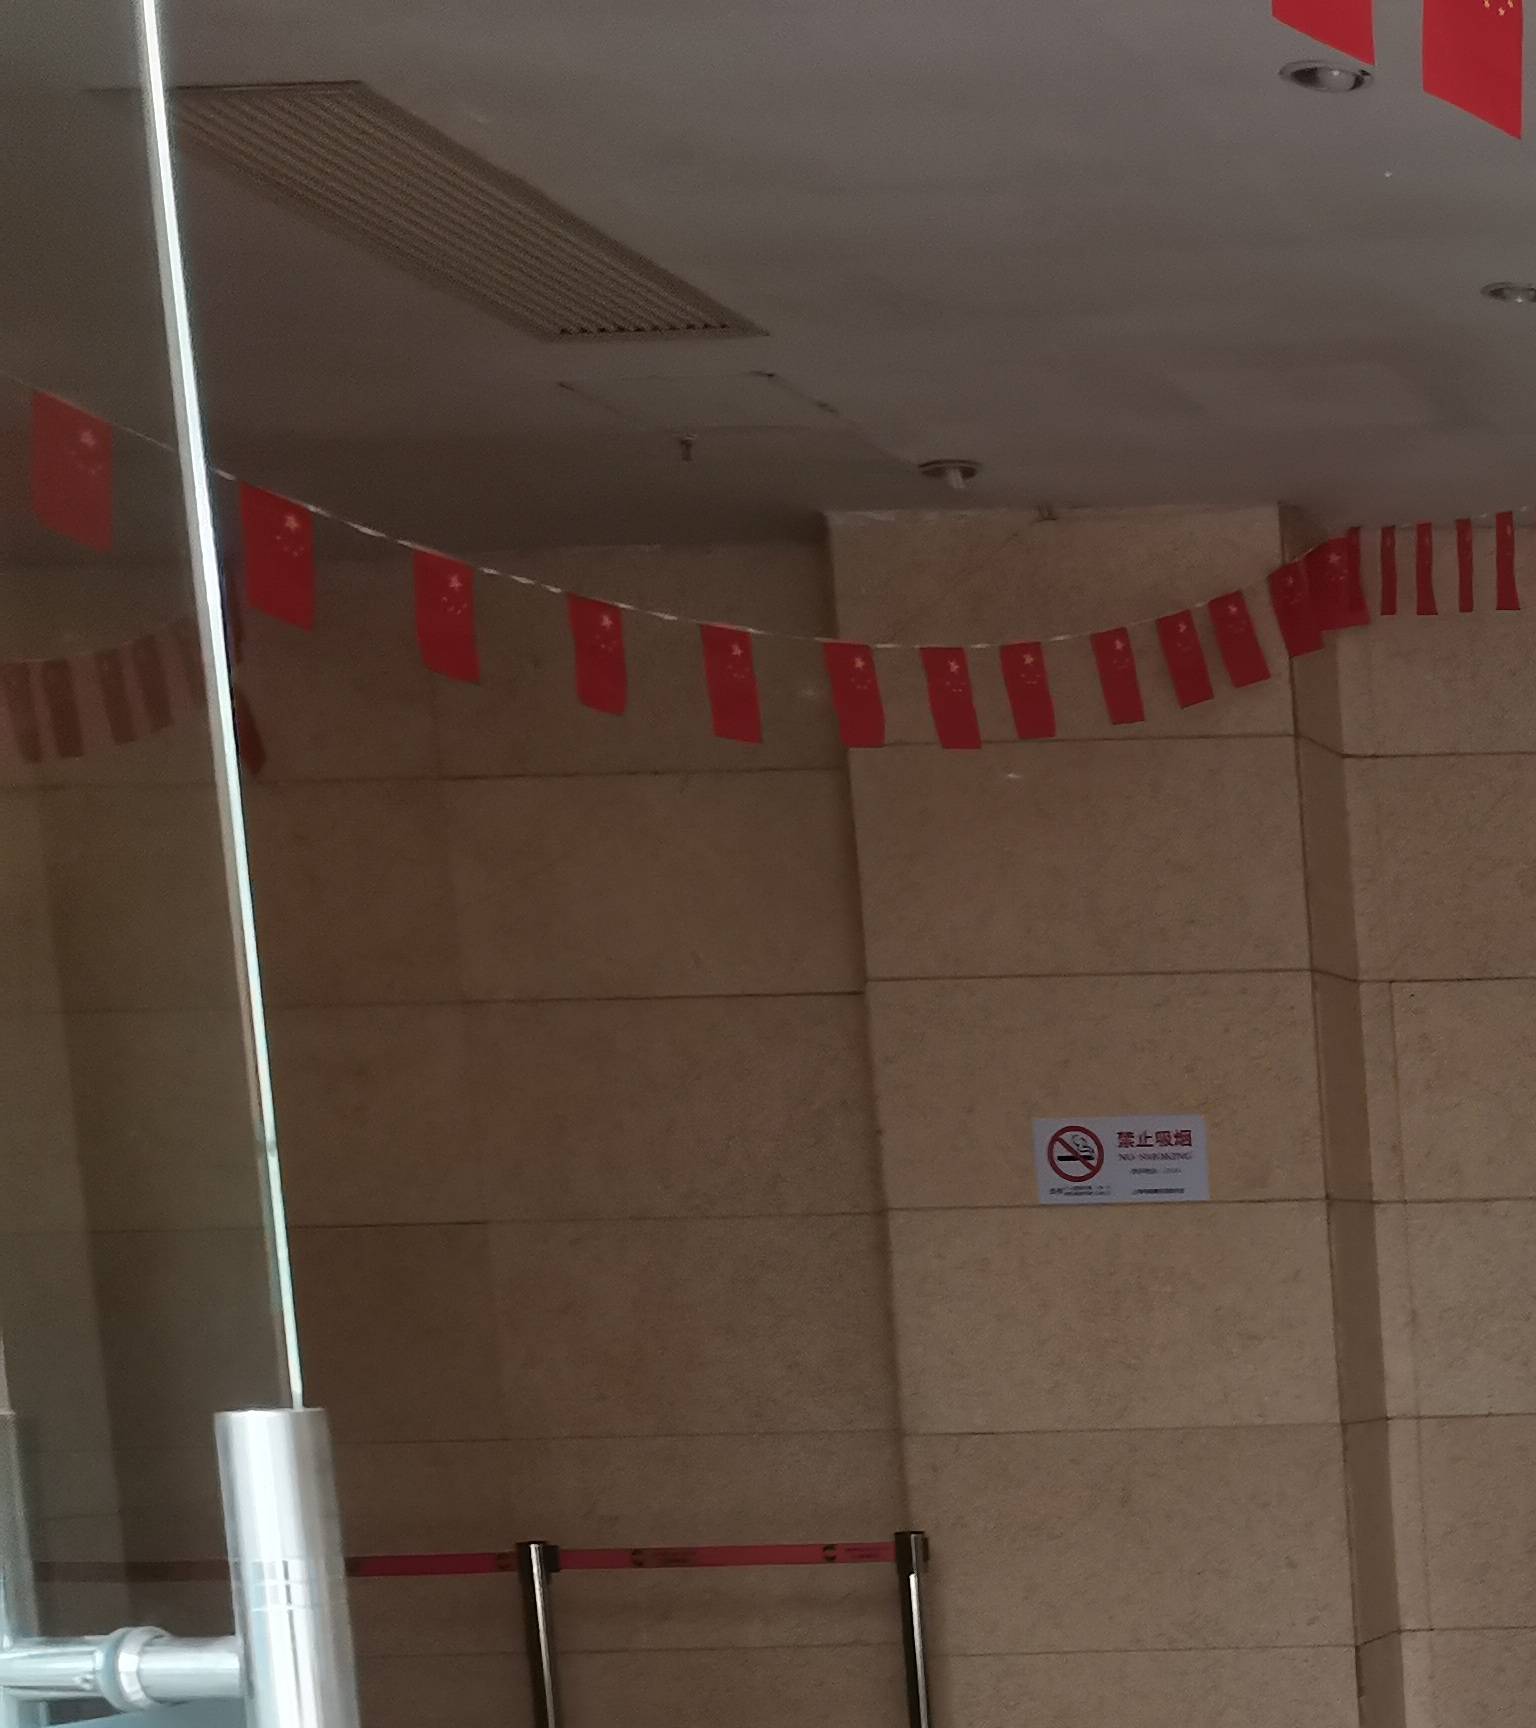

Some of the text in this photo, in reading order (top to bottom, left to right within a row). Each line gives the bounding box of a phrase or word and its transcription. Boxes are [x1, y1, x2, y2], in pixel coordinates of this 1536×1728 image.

[1116, 1129, 1193, 1149] 禁止吸烟
[1118, 1153, 1136, 1162] NO
